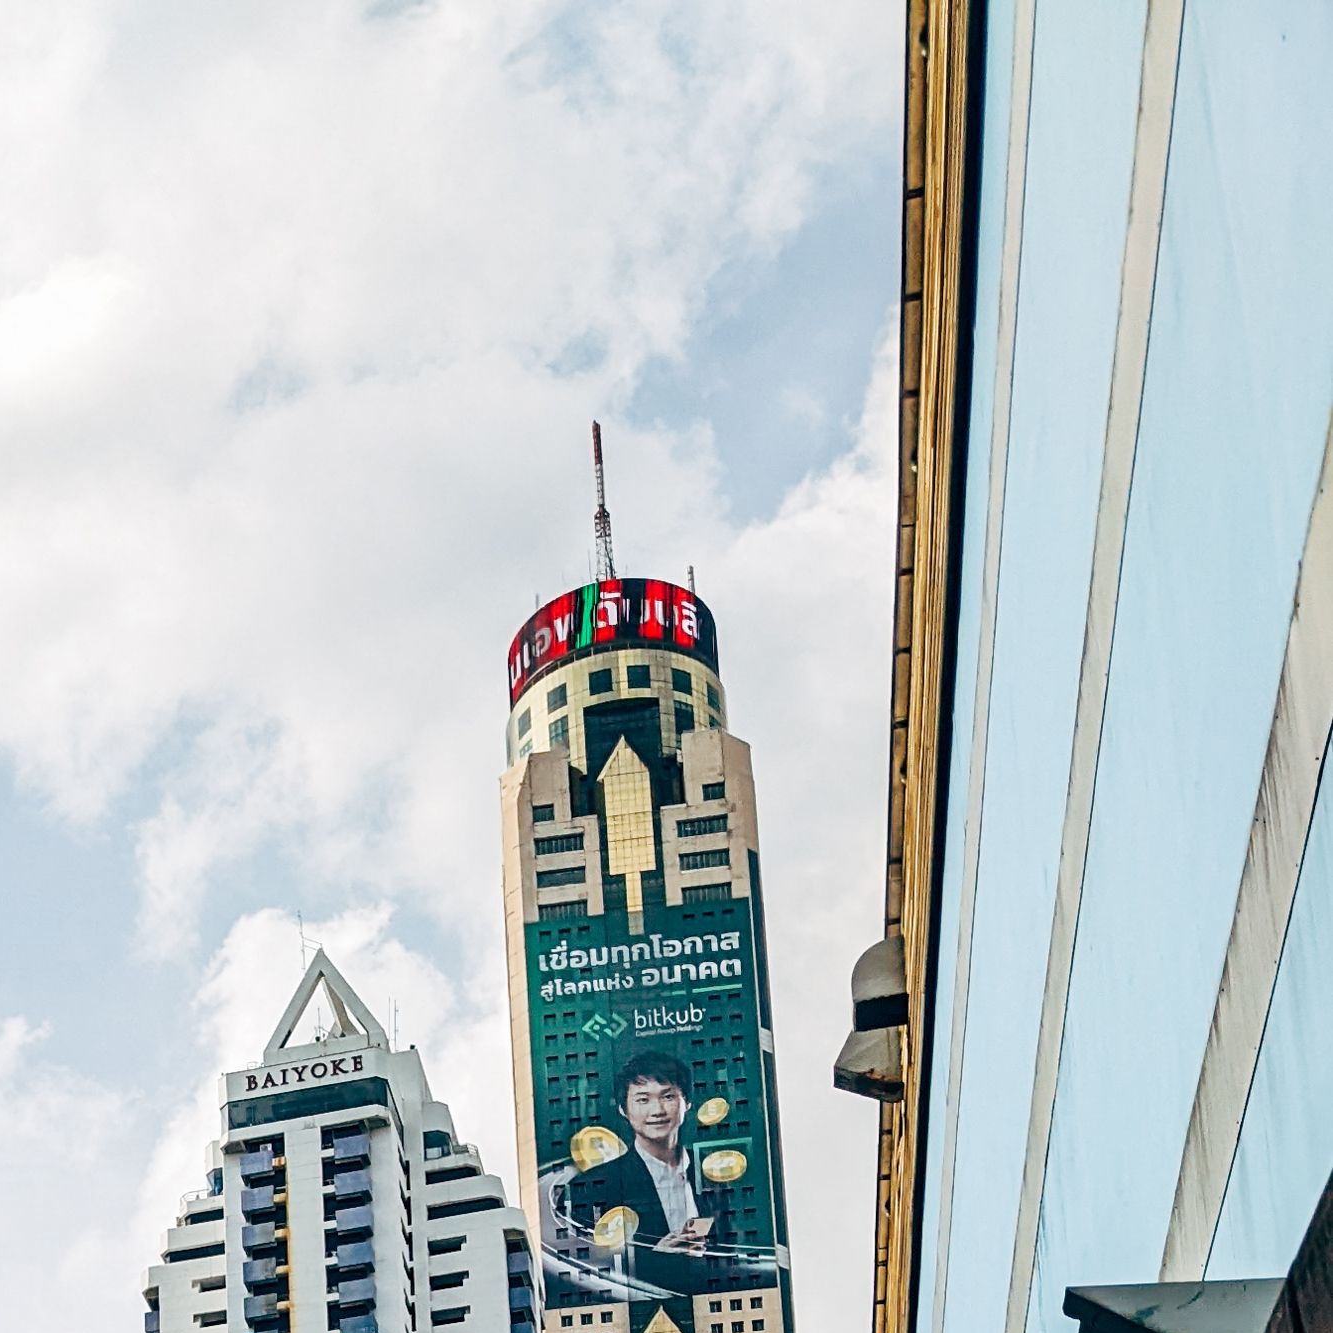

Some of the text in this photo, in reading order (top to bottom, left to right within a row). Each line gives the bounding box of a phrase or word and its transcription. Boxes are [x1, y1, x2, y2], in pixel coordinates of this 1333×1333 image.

[538, 931, 740, 972] เชื่อมทุกโอกาส
[540, 958, 742, 1002] สู่โลกแห่ง อนาคต
[634, 1003, 703, 1030] bitkub
[245, 1055, 364, 1091] BAIYOKE
